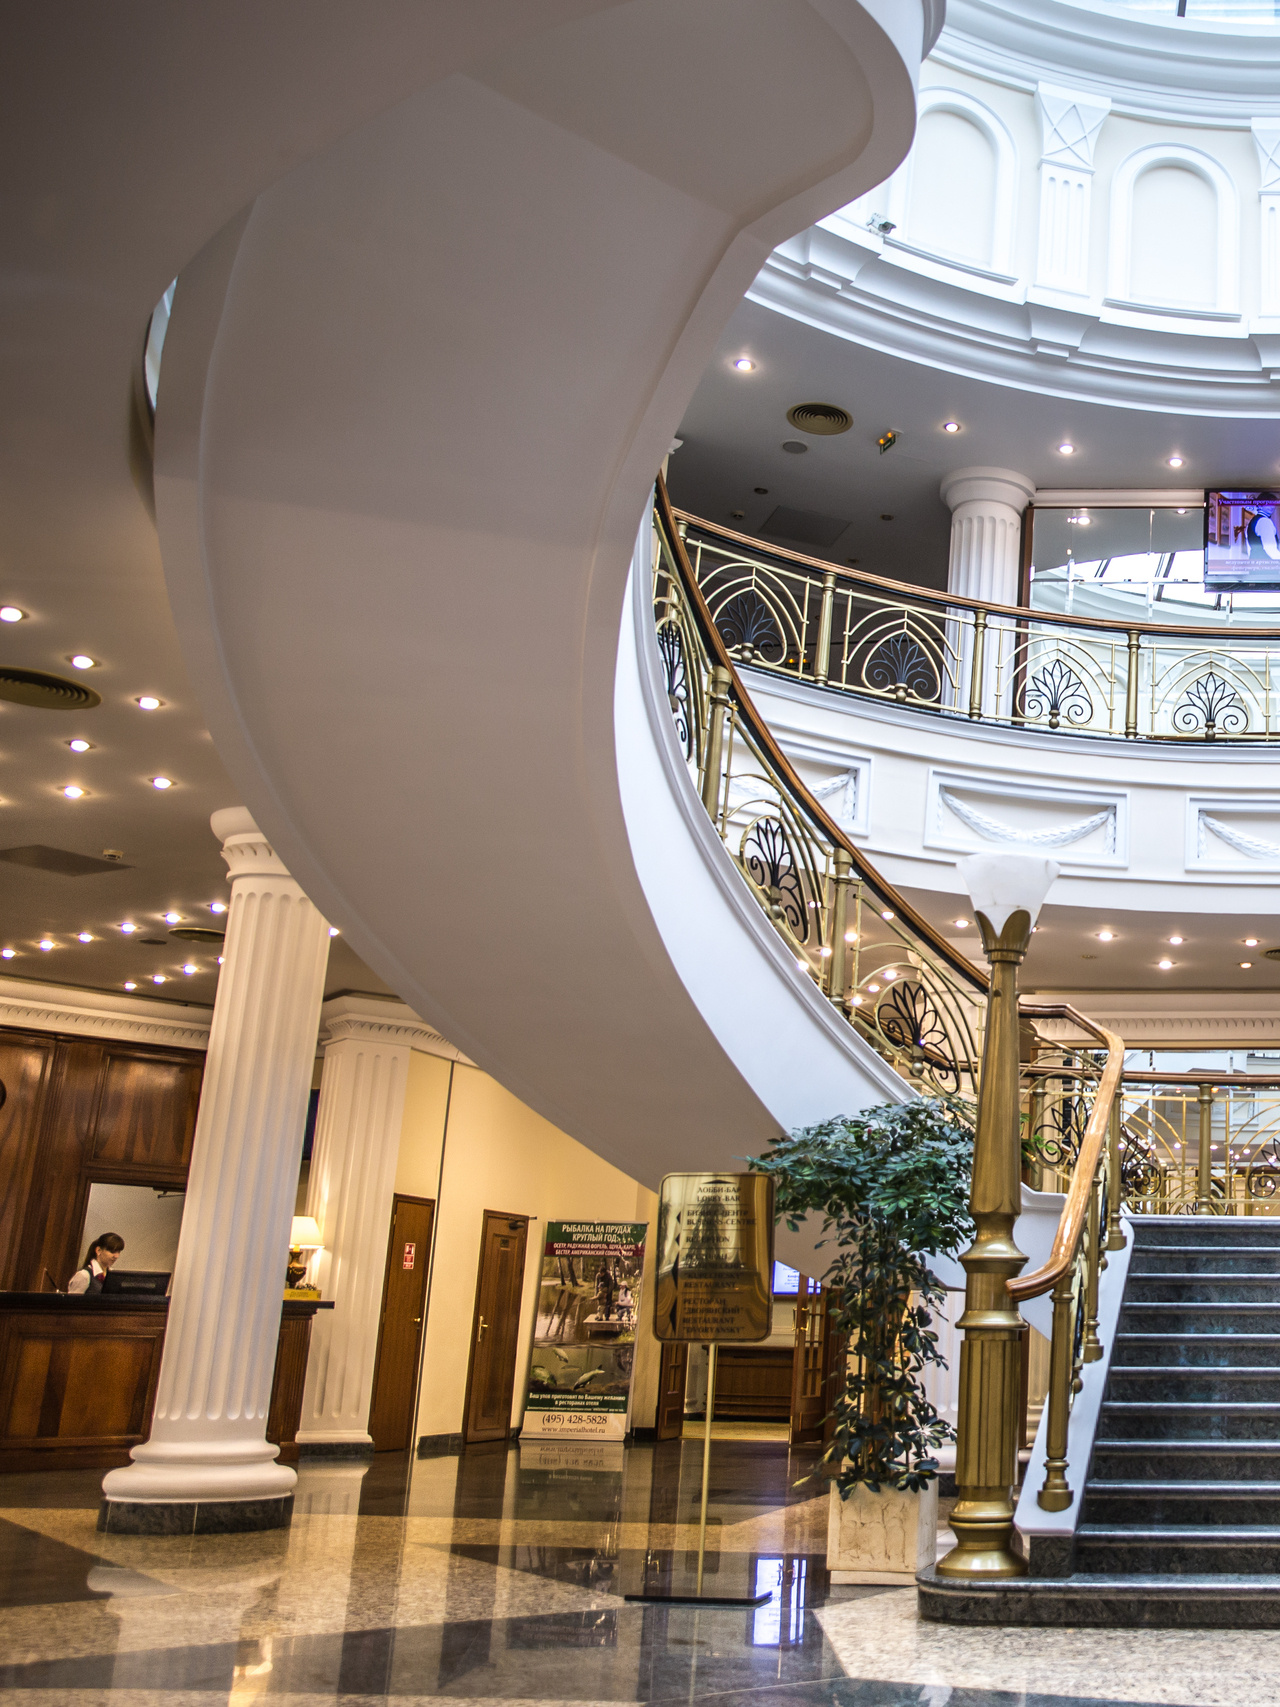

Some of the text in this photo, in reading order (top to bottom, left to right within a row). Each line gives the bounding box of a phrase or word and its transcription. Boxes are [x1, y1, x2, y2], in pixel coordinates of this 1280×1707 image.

[562, 1224, 632, 1235] РЫБАЛКА НА ПРУДАХ
[572, 1233, 603, 1241] КРУГЛЫЙ
[542, 1414, 608, 1425] (495) 428-5828
[541, 1426, 606, 1434] www.imperialhotel.ru
